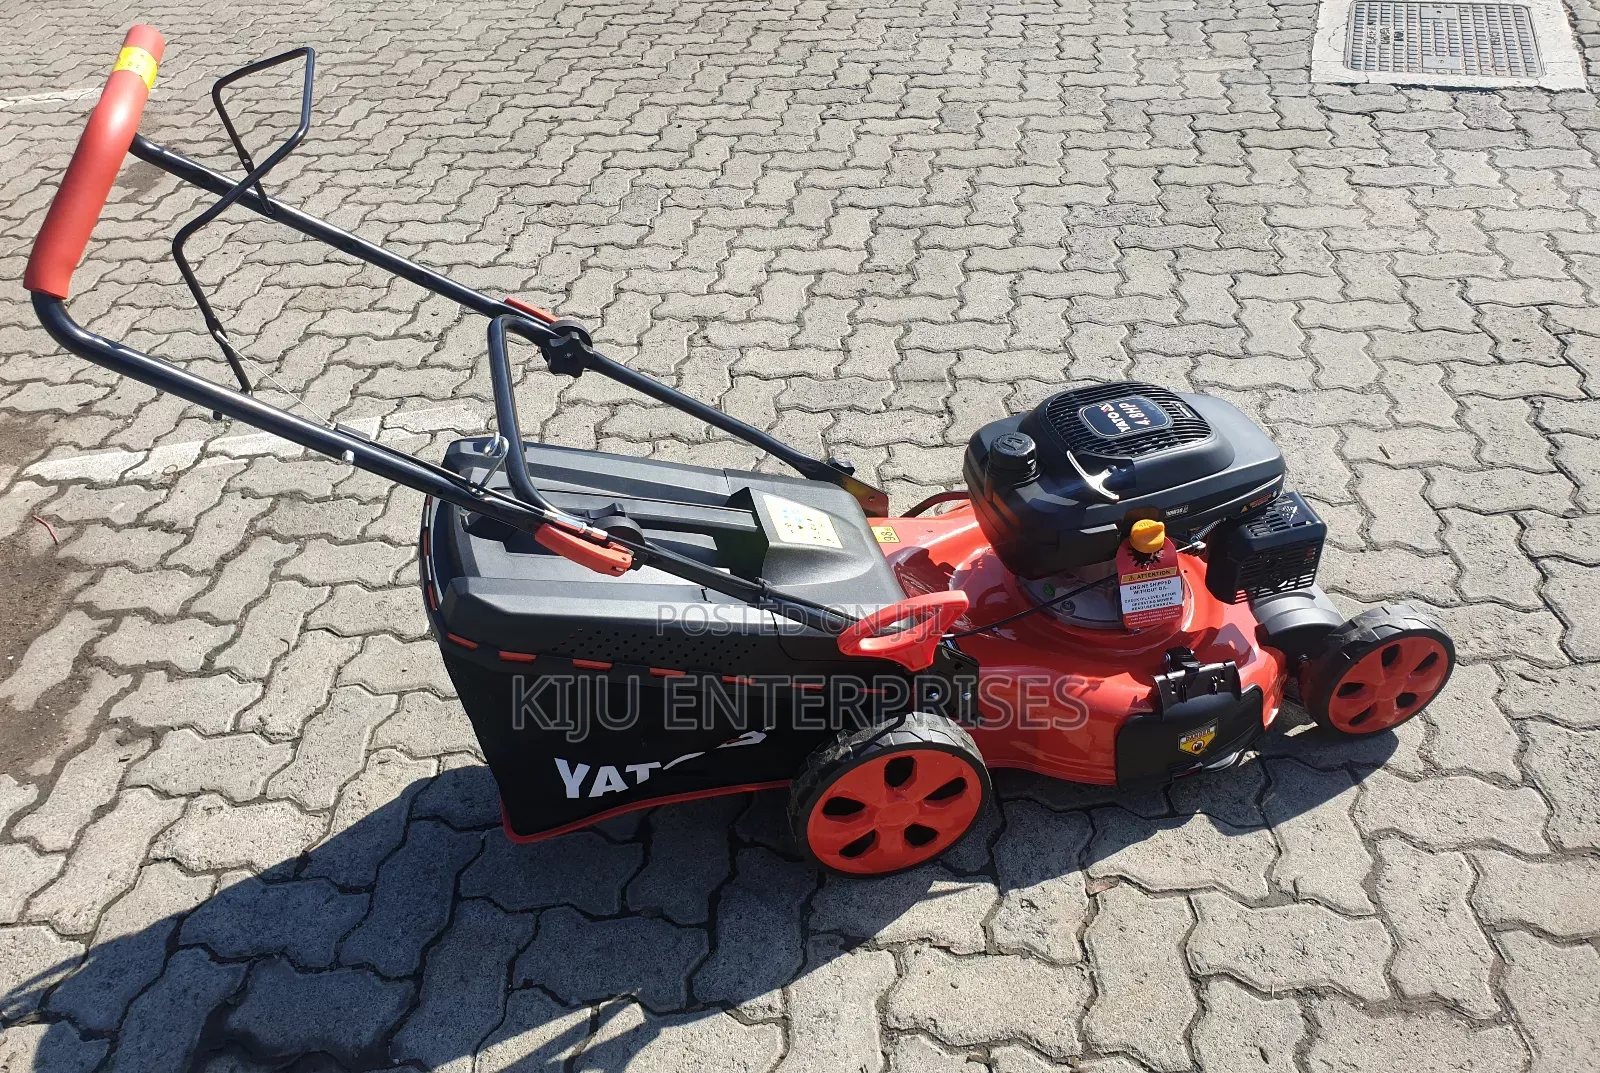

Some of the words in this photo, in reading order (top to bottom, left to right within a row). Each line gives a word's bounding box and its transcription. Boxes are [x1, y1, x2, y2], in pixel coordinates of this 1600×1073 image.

[1107, 411, 1131, 433] YATO
[1118, 402, 1151, 426] 4.8HP
[1137, 570, 1170, 580] ATTENTION
[554, 757, 702, 798] YAT
